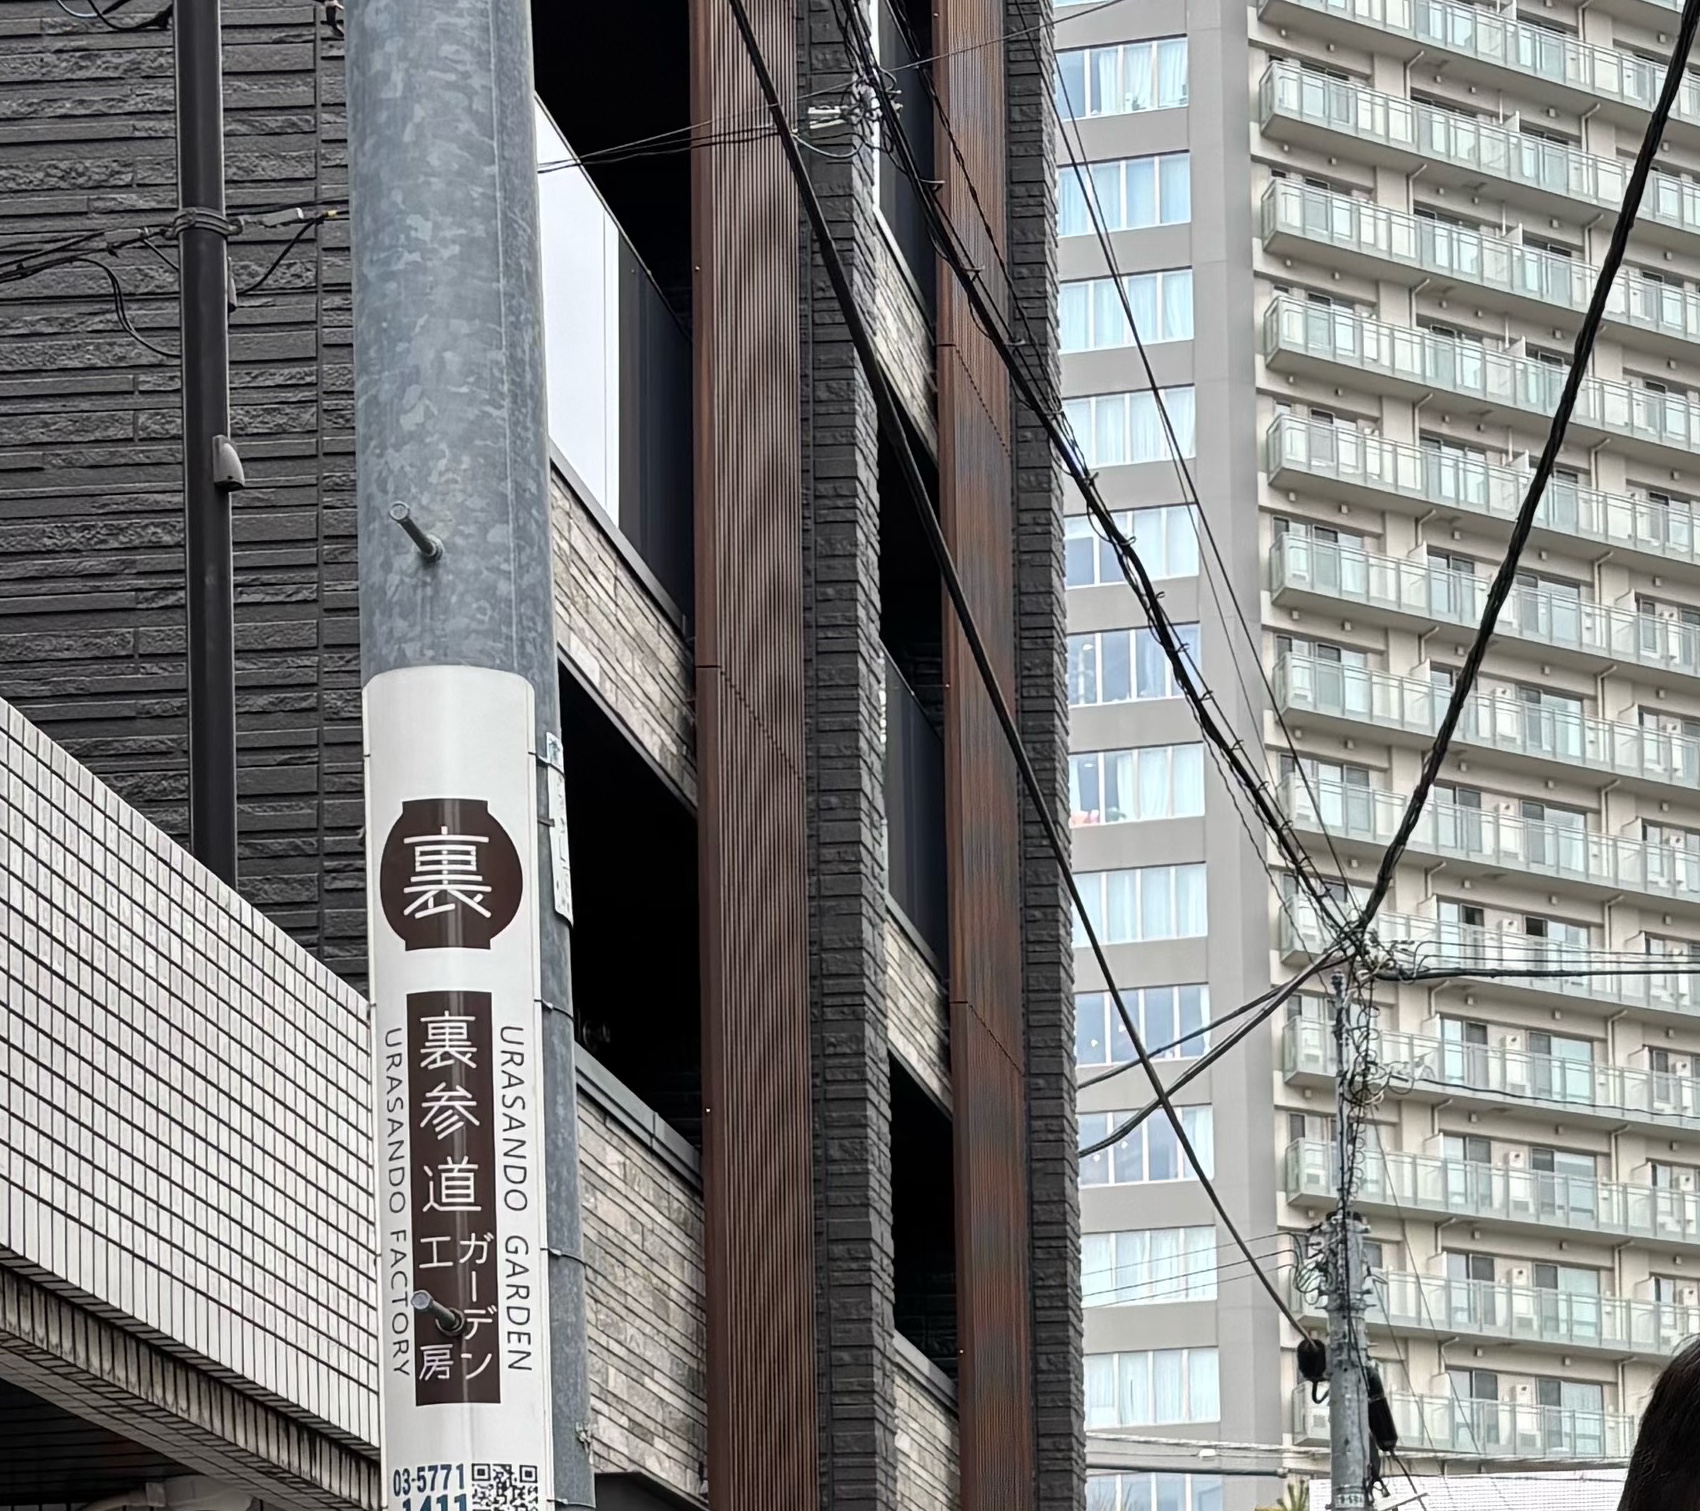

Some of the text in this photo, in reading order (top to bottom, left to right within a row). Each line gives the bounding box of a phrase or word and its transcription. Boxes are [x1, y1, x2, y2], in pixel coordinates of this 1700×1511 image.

[402, 824, 493, 920] 裏
[384, 1026, 411, 1377] URASANDO FACTORY
[419, 1009, 482, 1214] 裏参道
[499, 1025, 532, 1372] URASANDO GARDEN
[393, 1463, 465, 1497] 03-5771
